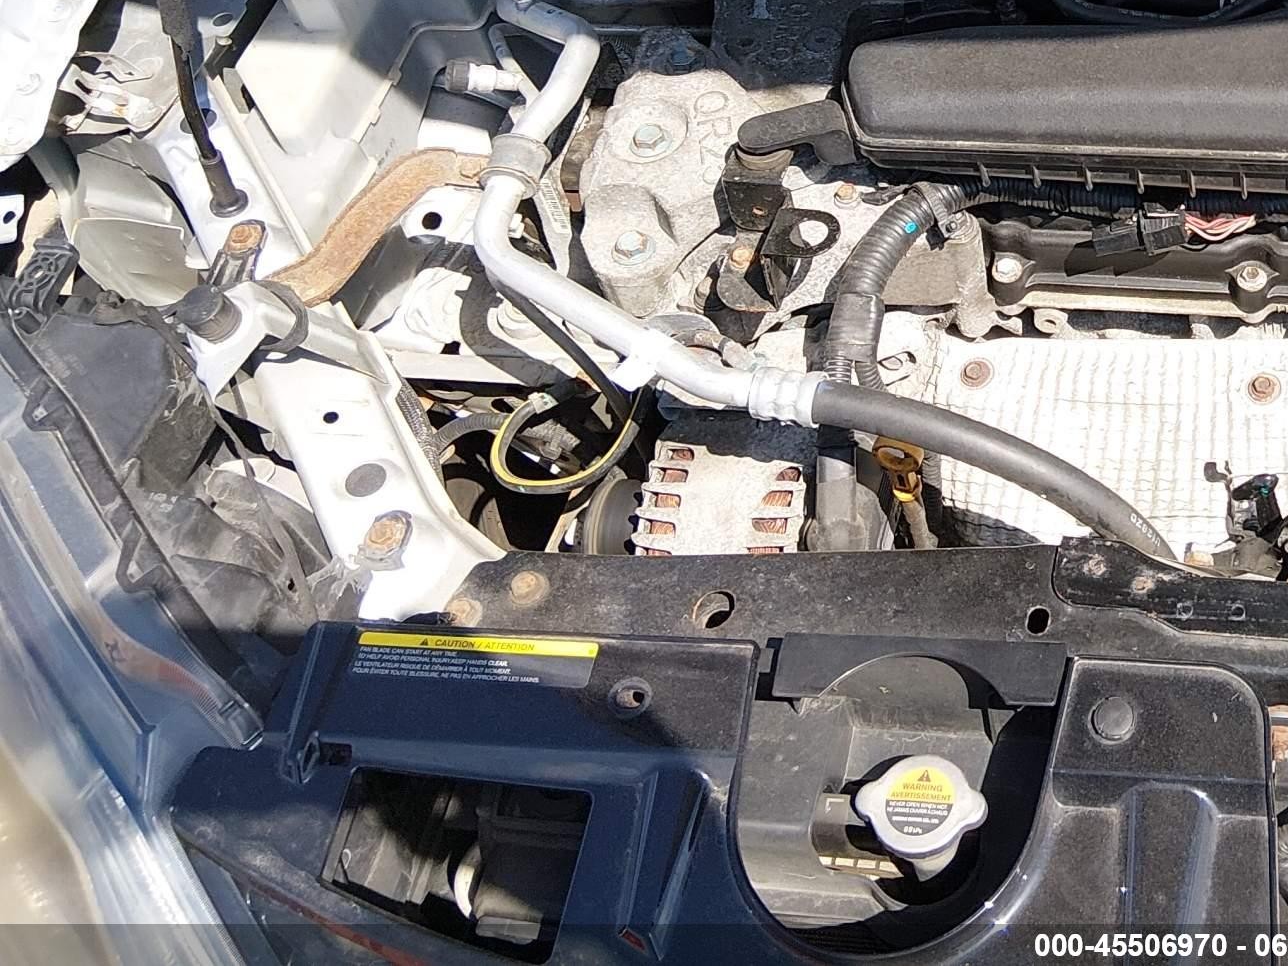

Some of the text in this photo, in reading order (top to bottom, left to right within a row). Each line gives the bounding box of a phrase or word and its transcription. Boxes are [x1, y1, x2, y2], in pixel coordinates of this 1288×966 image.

[434, 638, 475, 649] CAUTION
[485, 641, 535, 651] ATTENTION
[902, 782, 943, 792] WARNING
[891, 792, 952, 802] AVERTISSEMENT
